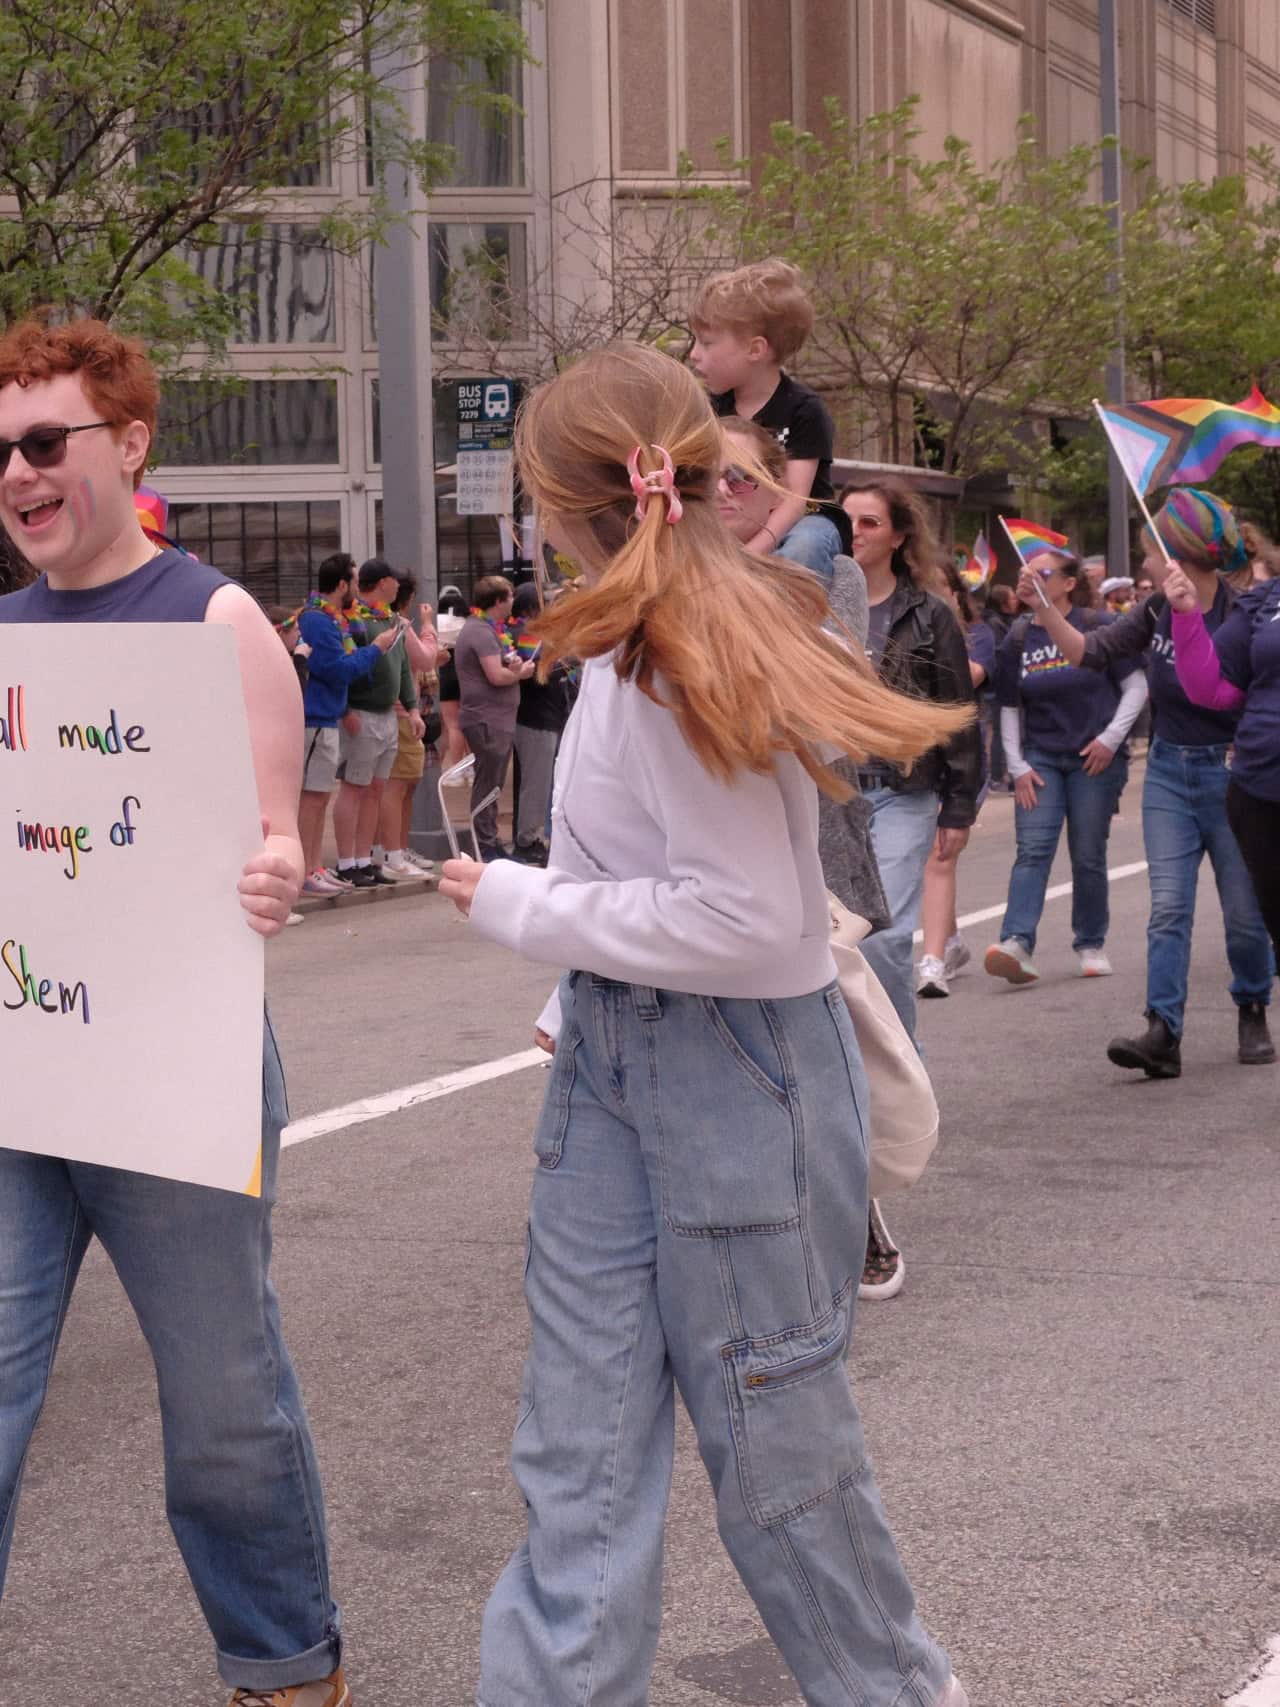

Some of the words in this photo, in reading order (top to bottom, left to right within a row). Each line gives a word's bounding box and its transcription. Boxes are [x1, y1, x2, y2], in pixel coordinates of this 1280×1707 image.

[458, 385, 481, 398] BUS
[458, 399, 481, 409] STOP
[58, 708, 151, 754] made
[16, 808, 93, 879] image
[109, 795, 141, 847] of
